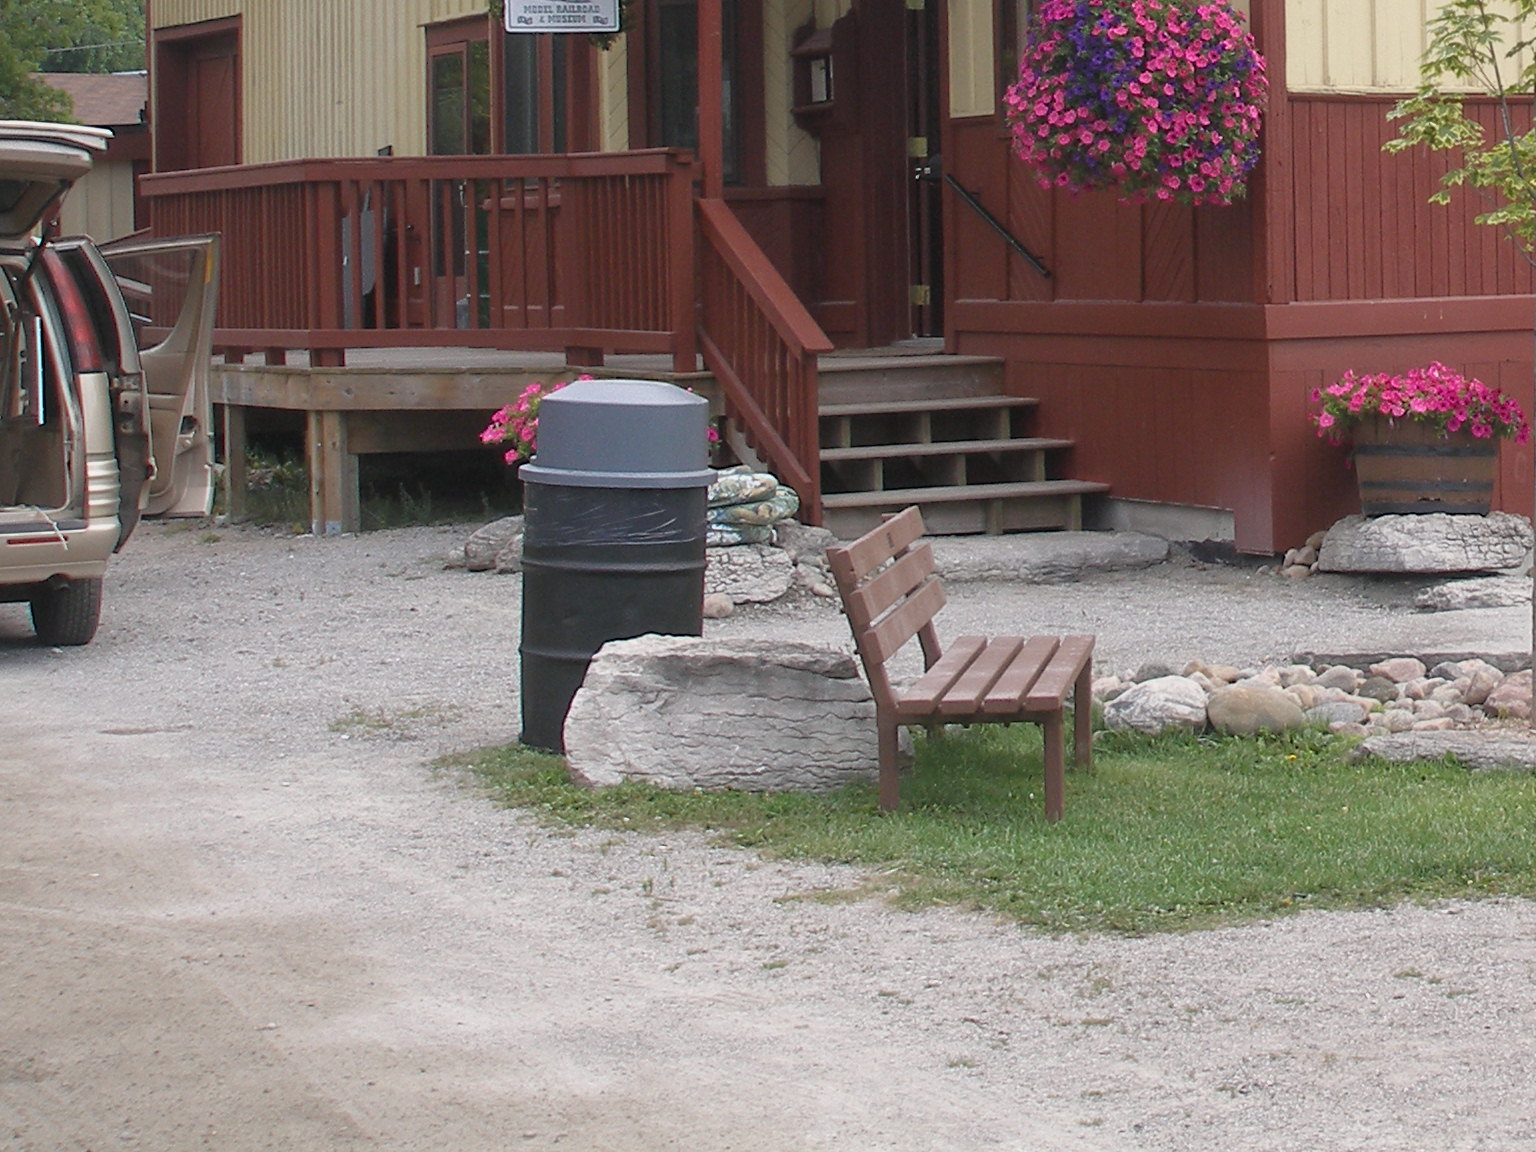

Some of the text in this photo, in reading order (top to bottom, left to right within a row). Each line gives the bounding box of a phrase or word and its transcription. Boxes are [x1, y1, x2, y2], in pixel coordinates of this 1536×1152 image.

[523, 5, 601, 14] MODEL RAILROAD
[548, 15, 586, 24] MUSEUM
